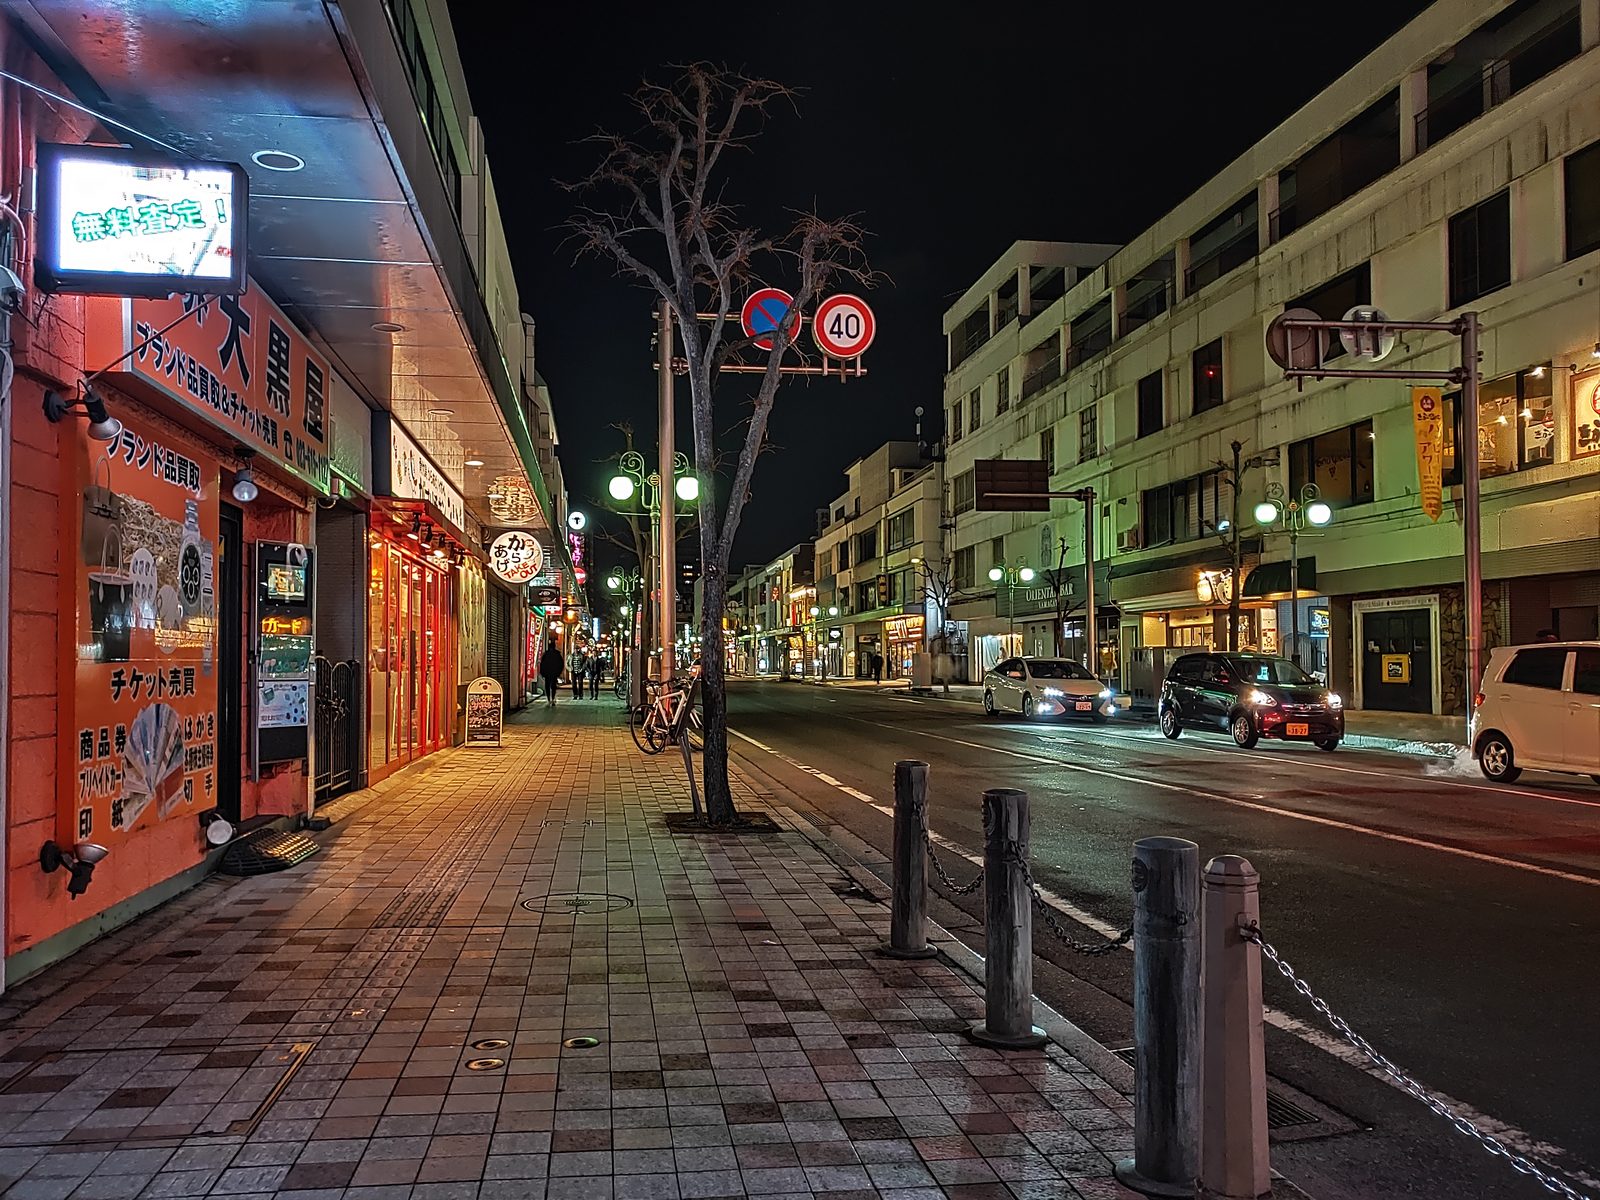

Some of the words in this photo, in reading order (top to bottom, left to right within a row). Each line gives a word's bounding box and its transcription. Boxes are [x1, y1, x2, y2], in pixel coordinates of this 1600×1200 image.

[829, 313, 860, 339] 40
[504, 562, 530, 579] TAKE
[519, 564, 538, 579] OUT
[1060, 583, 1074, 597] BAR
[111, 667, 196, 702] チケット売買
[183, 713, 214, 741] はがき
[79, 725, 127, 761] 商品券
[183, 772, 213, 803] 切手
